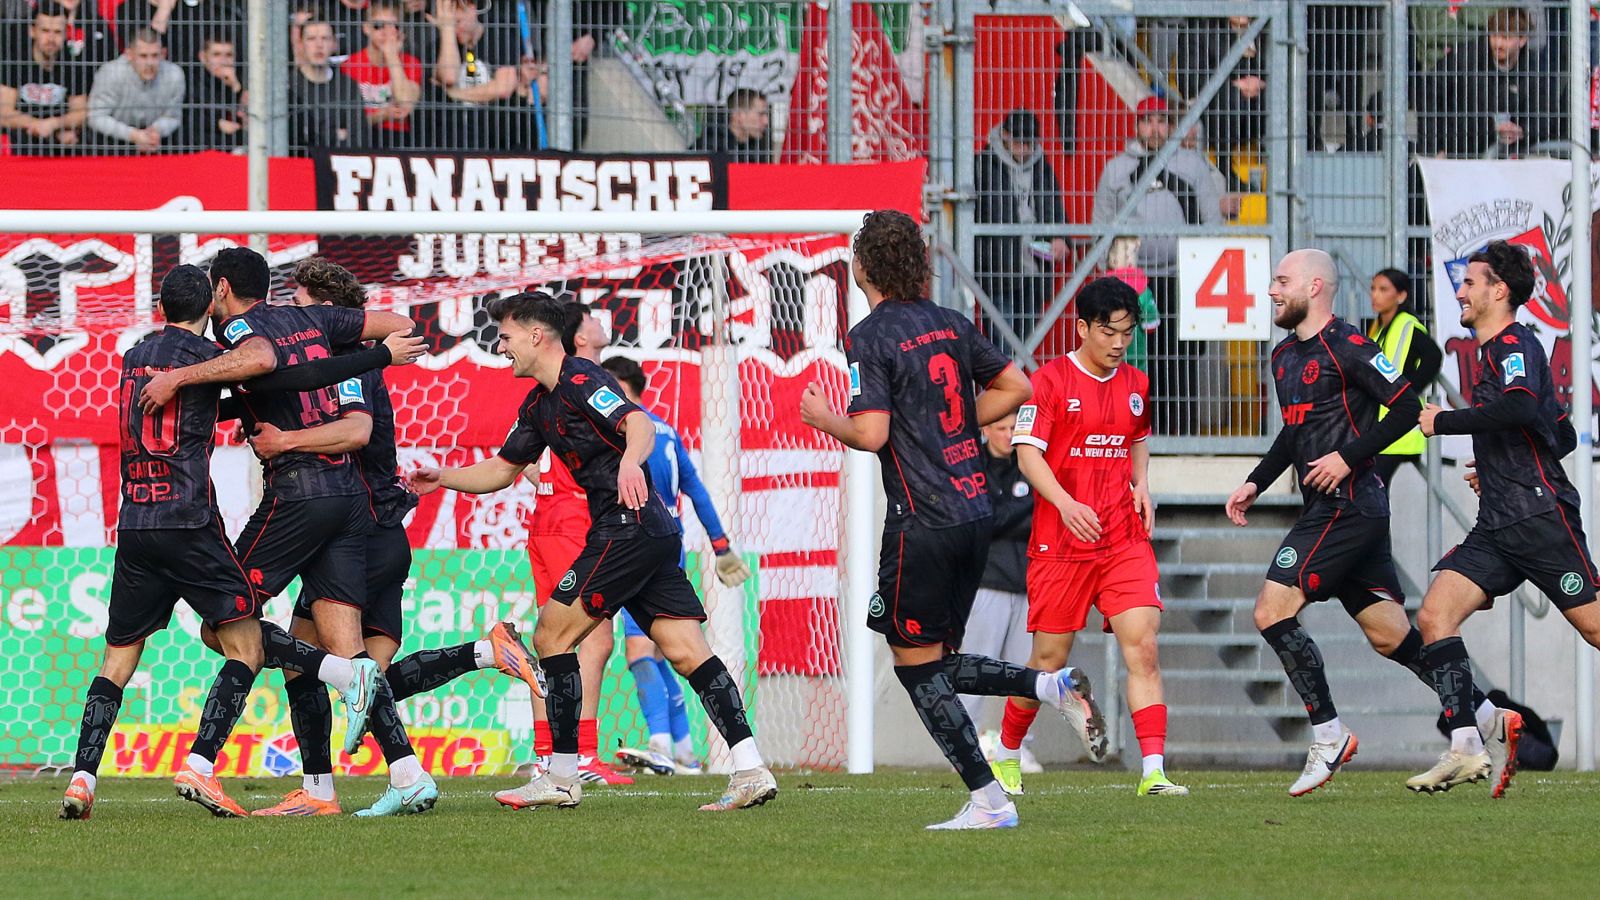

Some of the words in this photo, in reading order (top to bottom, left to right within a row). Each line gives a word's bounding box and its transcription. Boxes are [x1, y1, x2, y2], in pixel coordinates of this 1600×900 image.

[330, 156, 713, 212] FANATISCHE
[399, 232, 642, 279] JUGEND
[1195, 248, 1256, 324] 4
[928, 352, 965, 438] 3
[1085, 434, 1126, 446] evo
[128, 461, 171, 480] GARCIA
